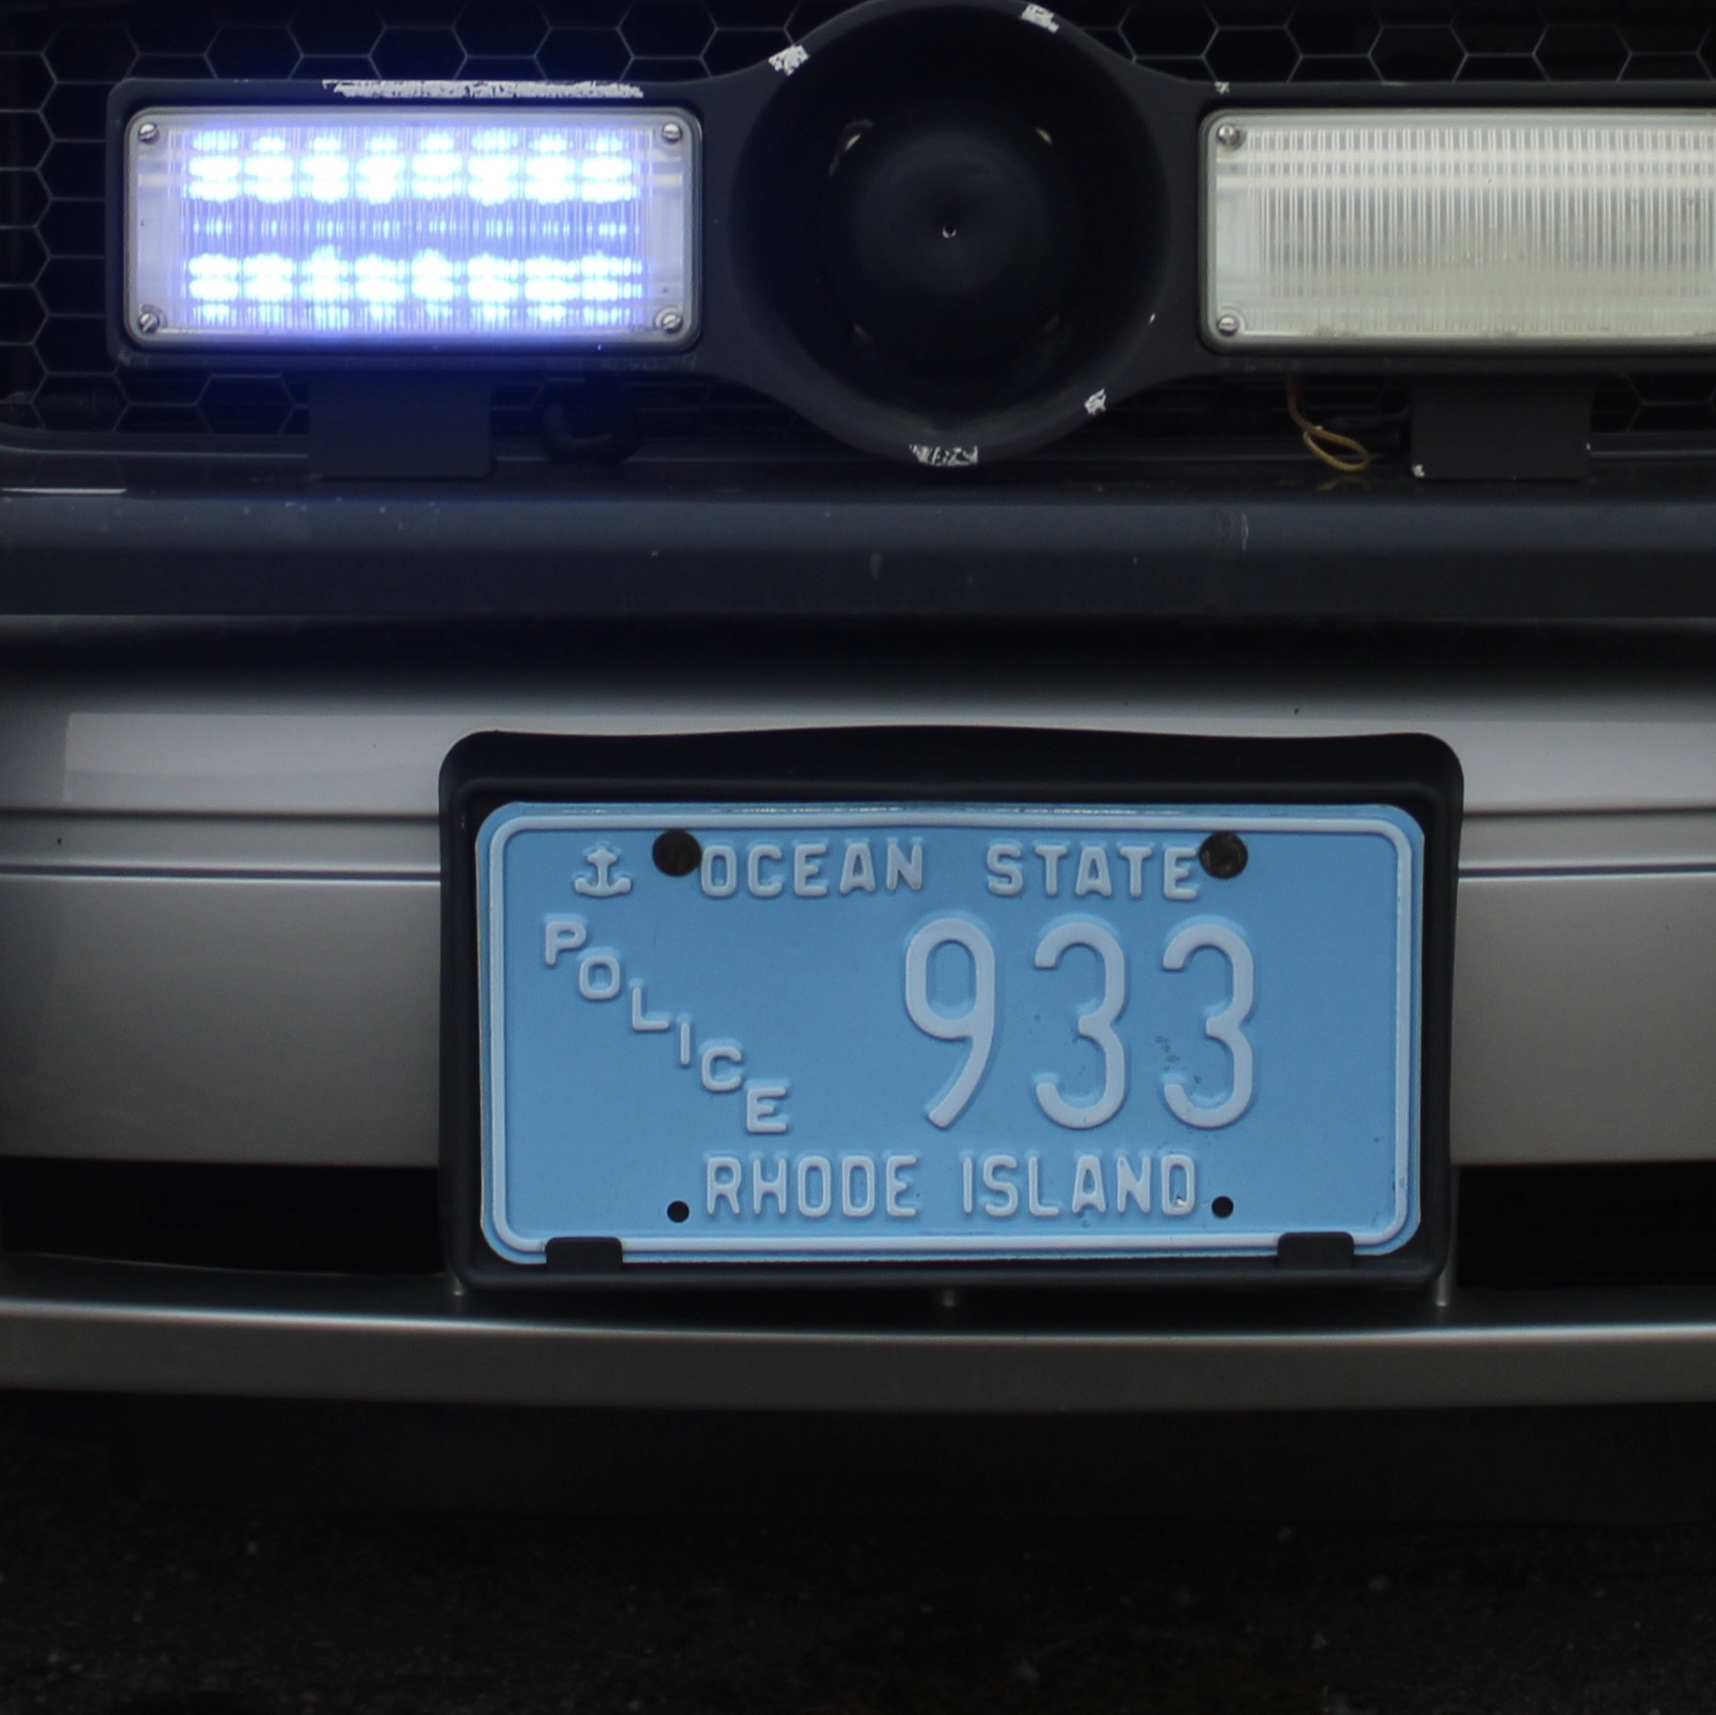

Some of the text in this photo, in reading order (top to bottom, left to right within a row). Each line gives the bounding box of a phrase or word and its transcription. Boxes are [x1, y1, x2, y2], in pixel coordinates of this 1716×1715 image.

[699, 842, 1200, 899] OCEAN STATE
[544, 915, 789, 1134] POLICE
[904, 917, 1255, 1129] 933
[705, 1154, 1198, 1217] RHODE ISLAND
